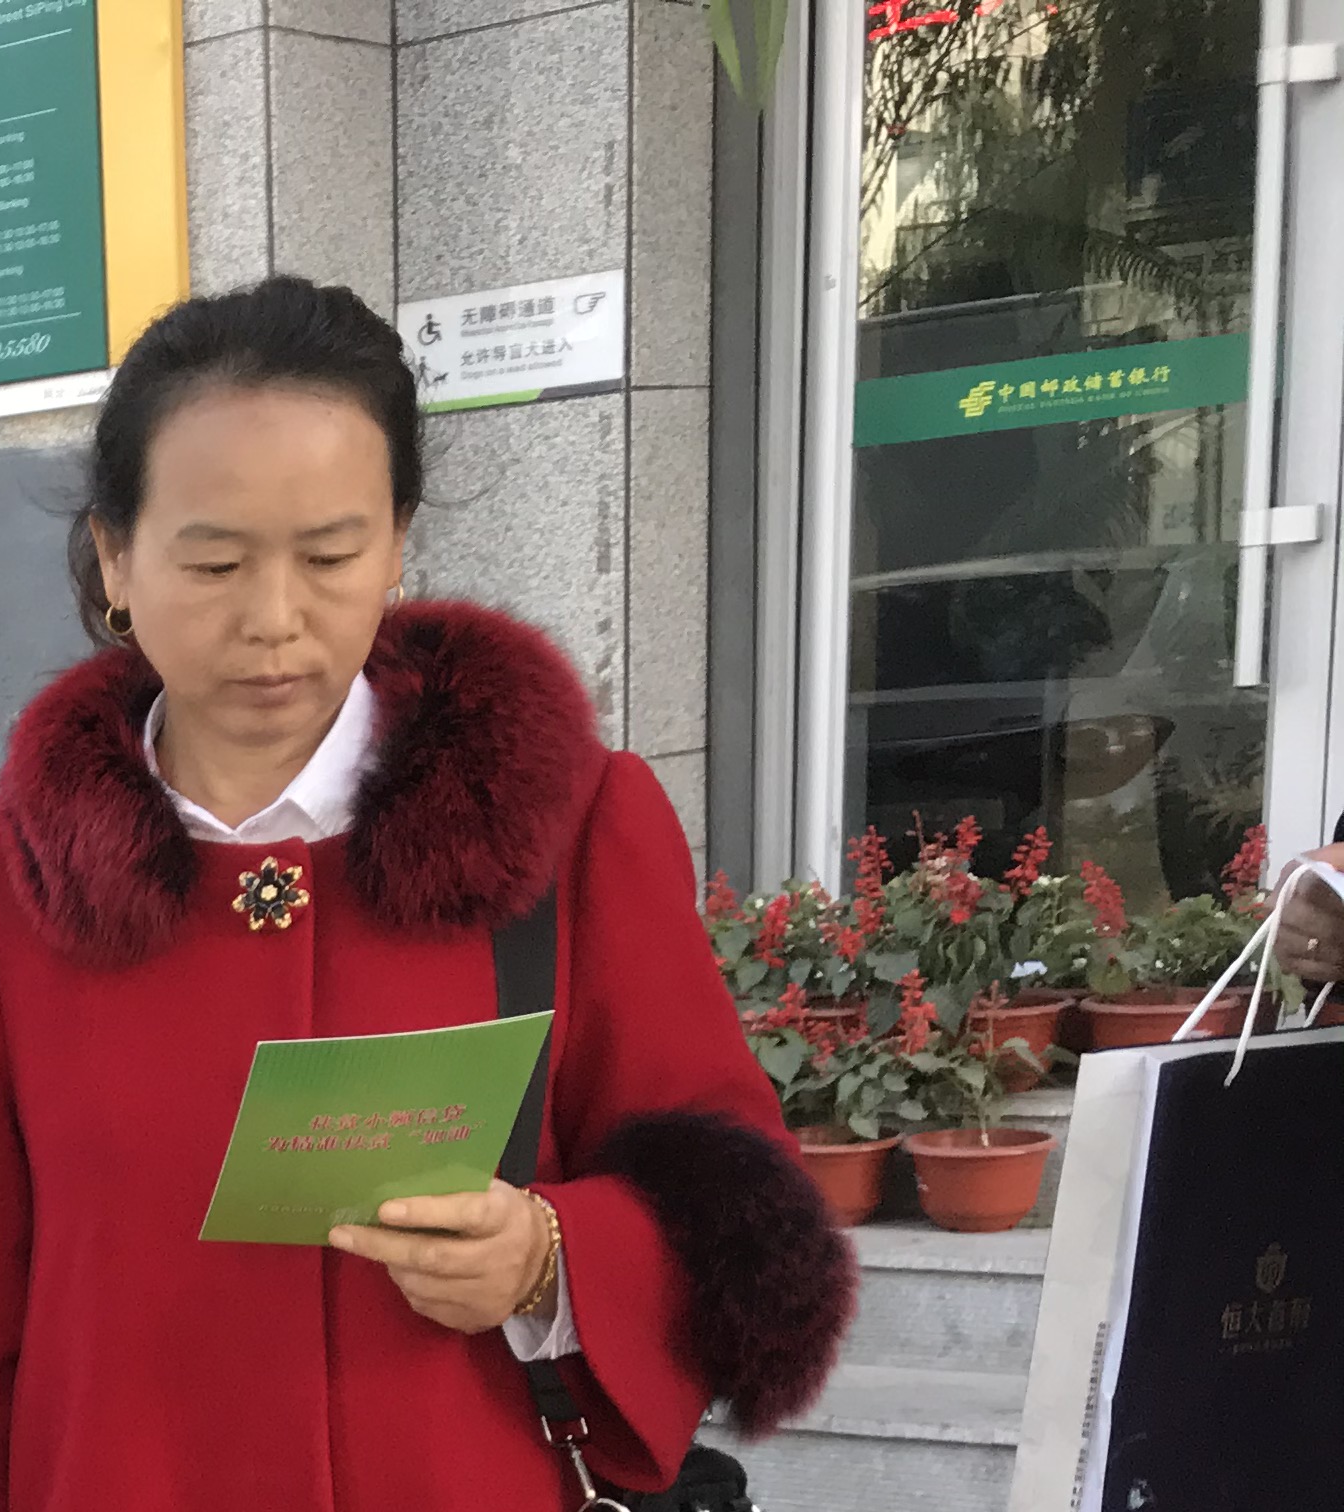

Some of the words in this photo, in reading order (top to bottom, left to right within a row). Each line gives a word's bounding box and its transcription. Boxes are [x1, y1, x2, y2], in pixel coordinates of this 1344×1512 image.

[461, 296, 556, 326] 无障碍通道
[460, 337, 573, 367] 允许导盲犬进入
[998, 365, 1172, 404] 中国邮政储蓄银行
